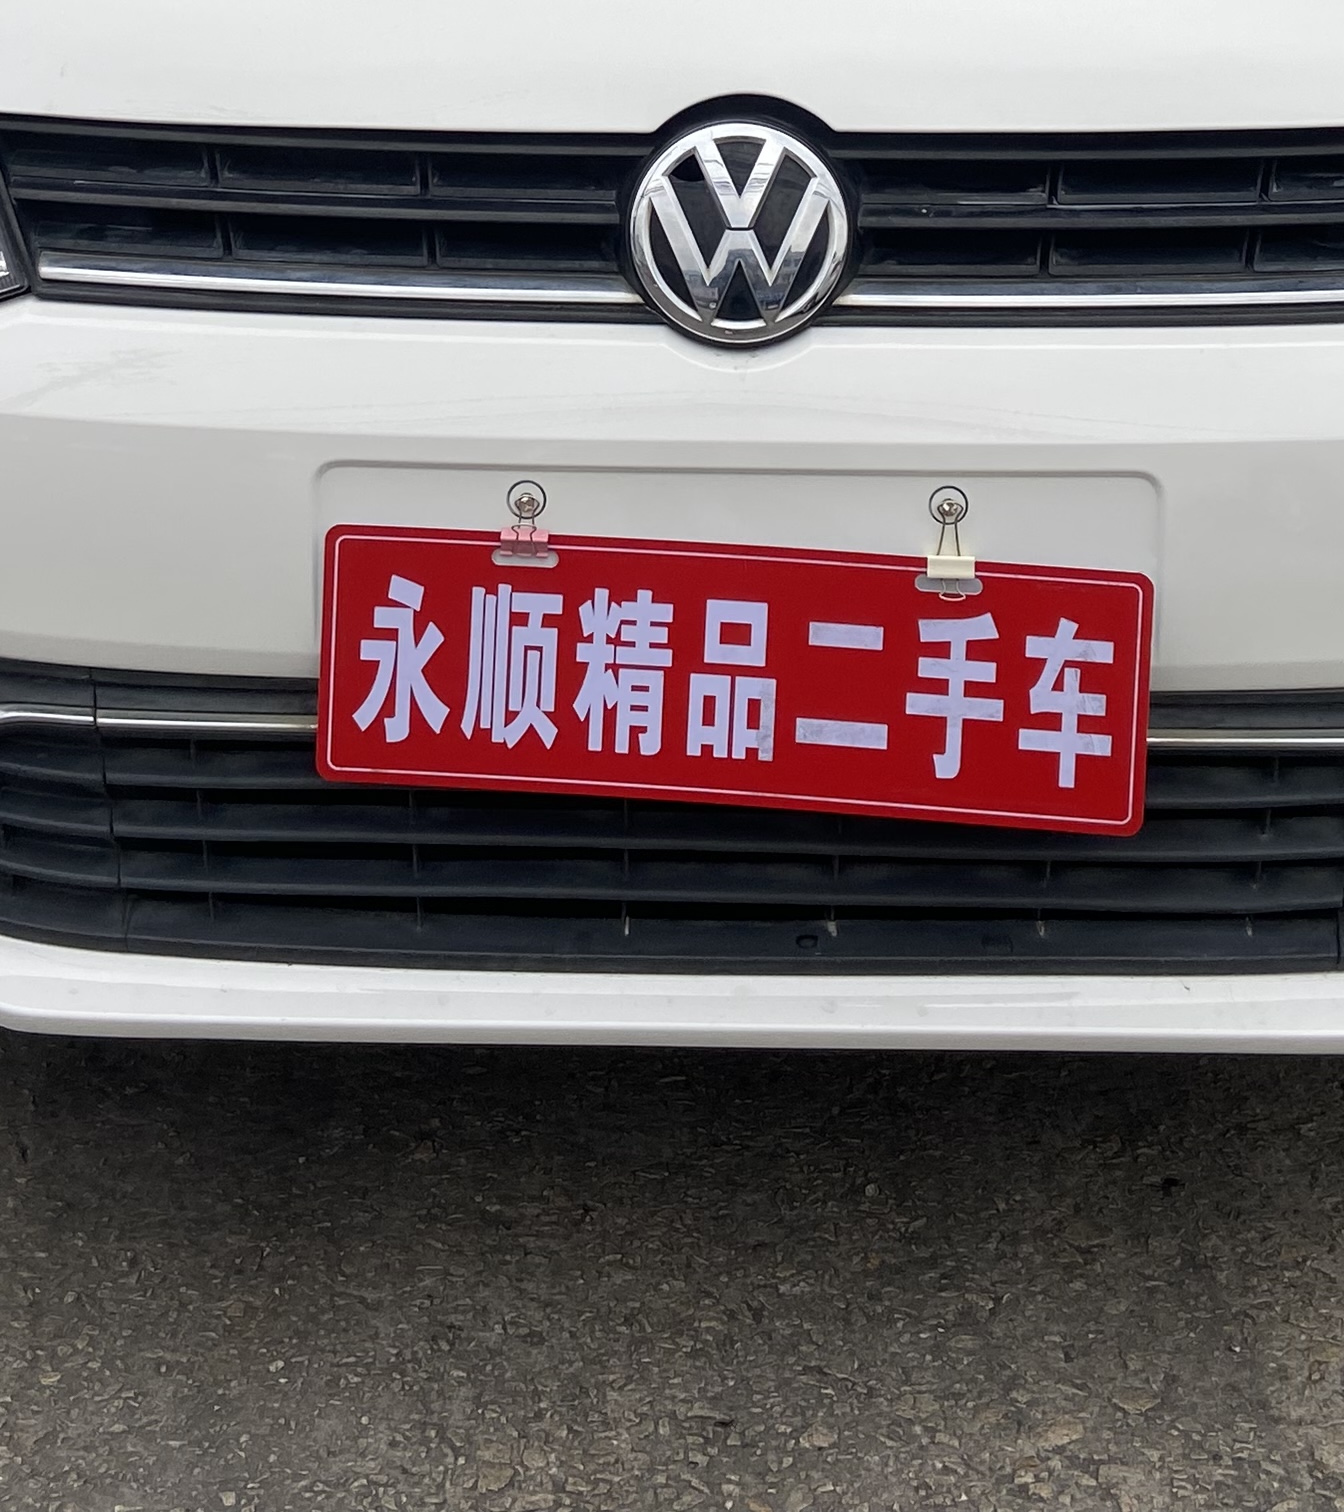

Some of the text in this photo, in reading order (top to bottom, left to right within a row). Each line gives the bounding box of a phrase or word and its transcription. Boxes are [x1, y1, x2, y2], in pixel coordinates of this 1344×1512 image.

[351, 574, 1115, 789] 永顺精品二手车
